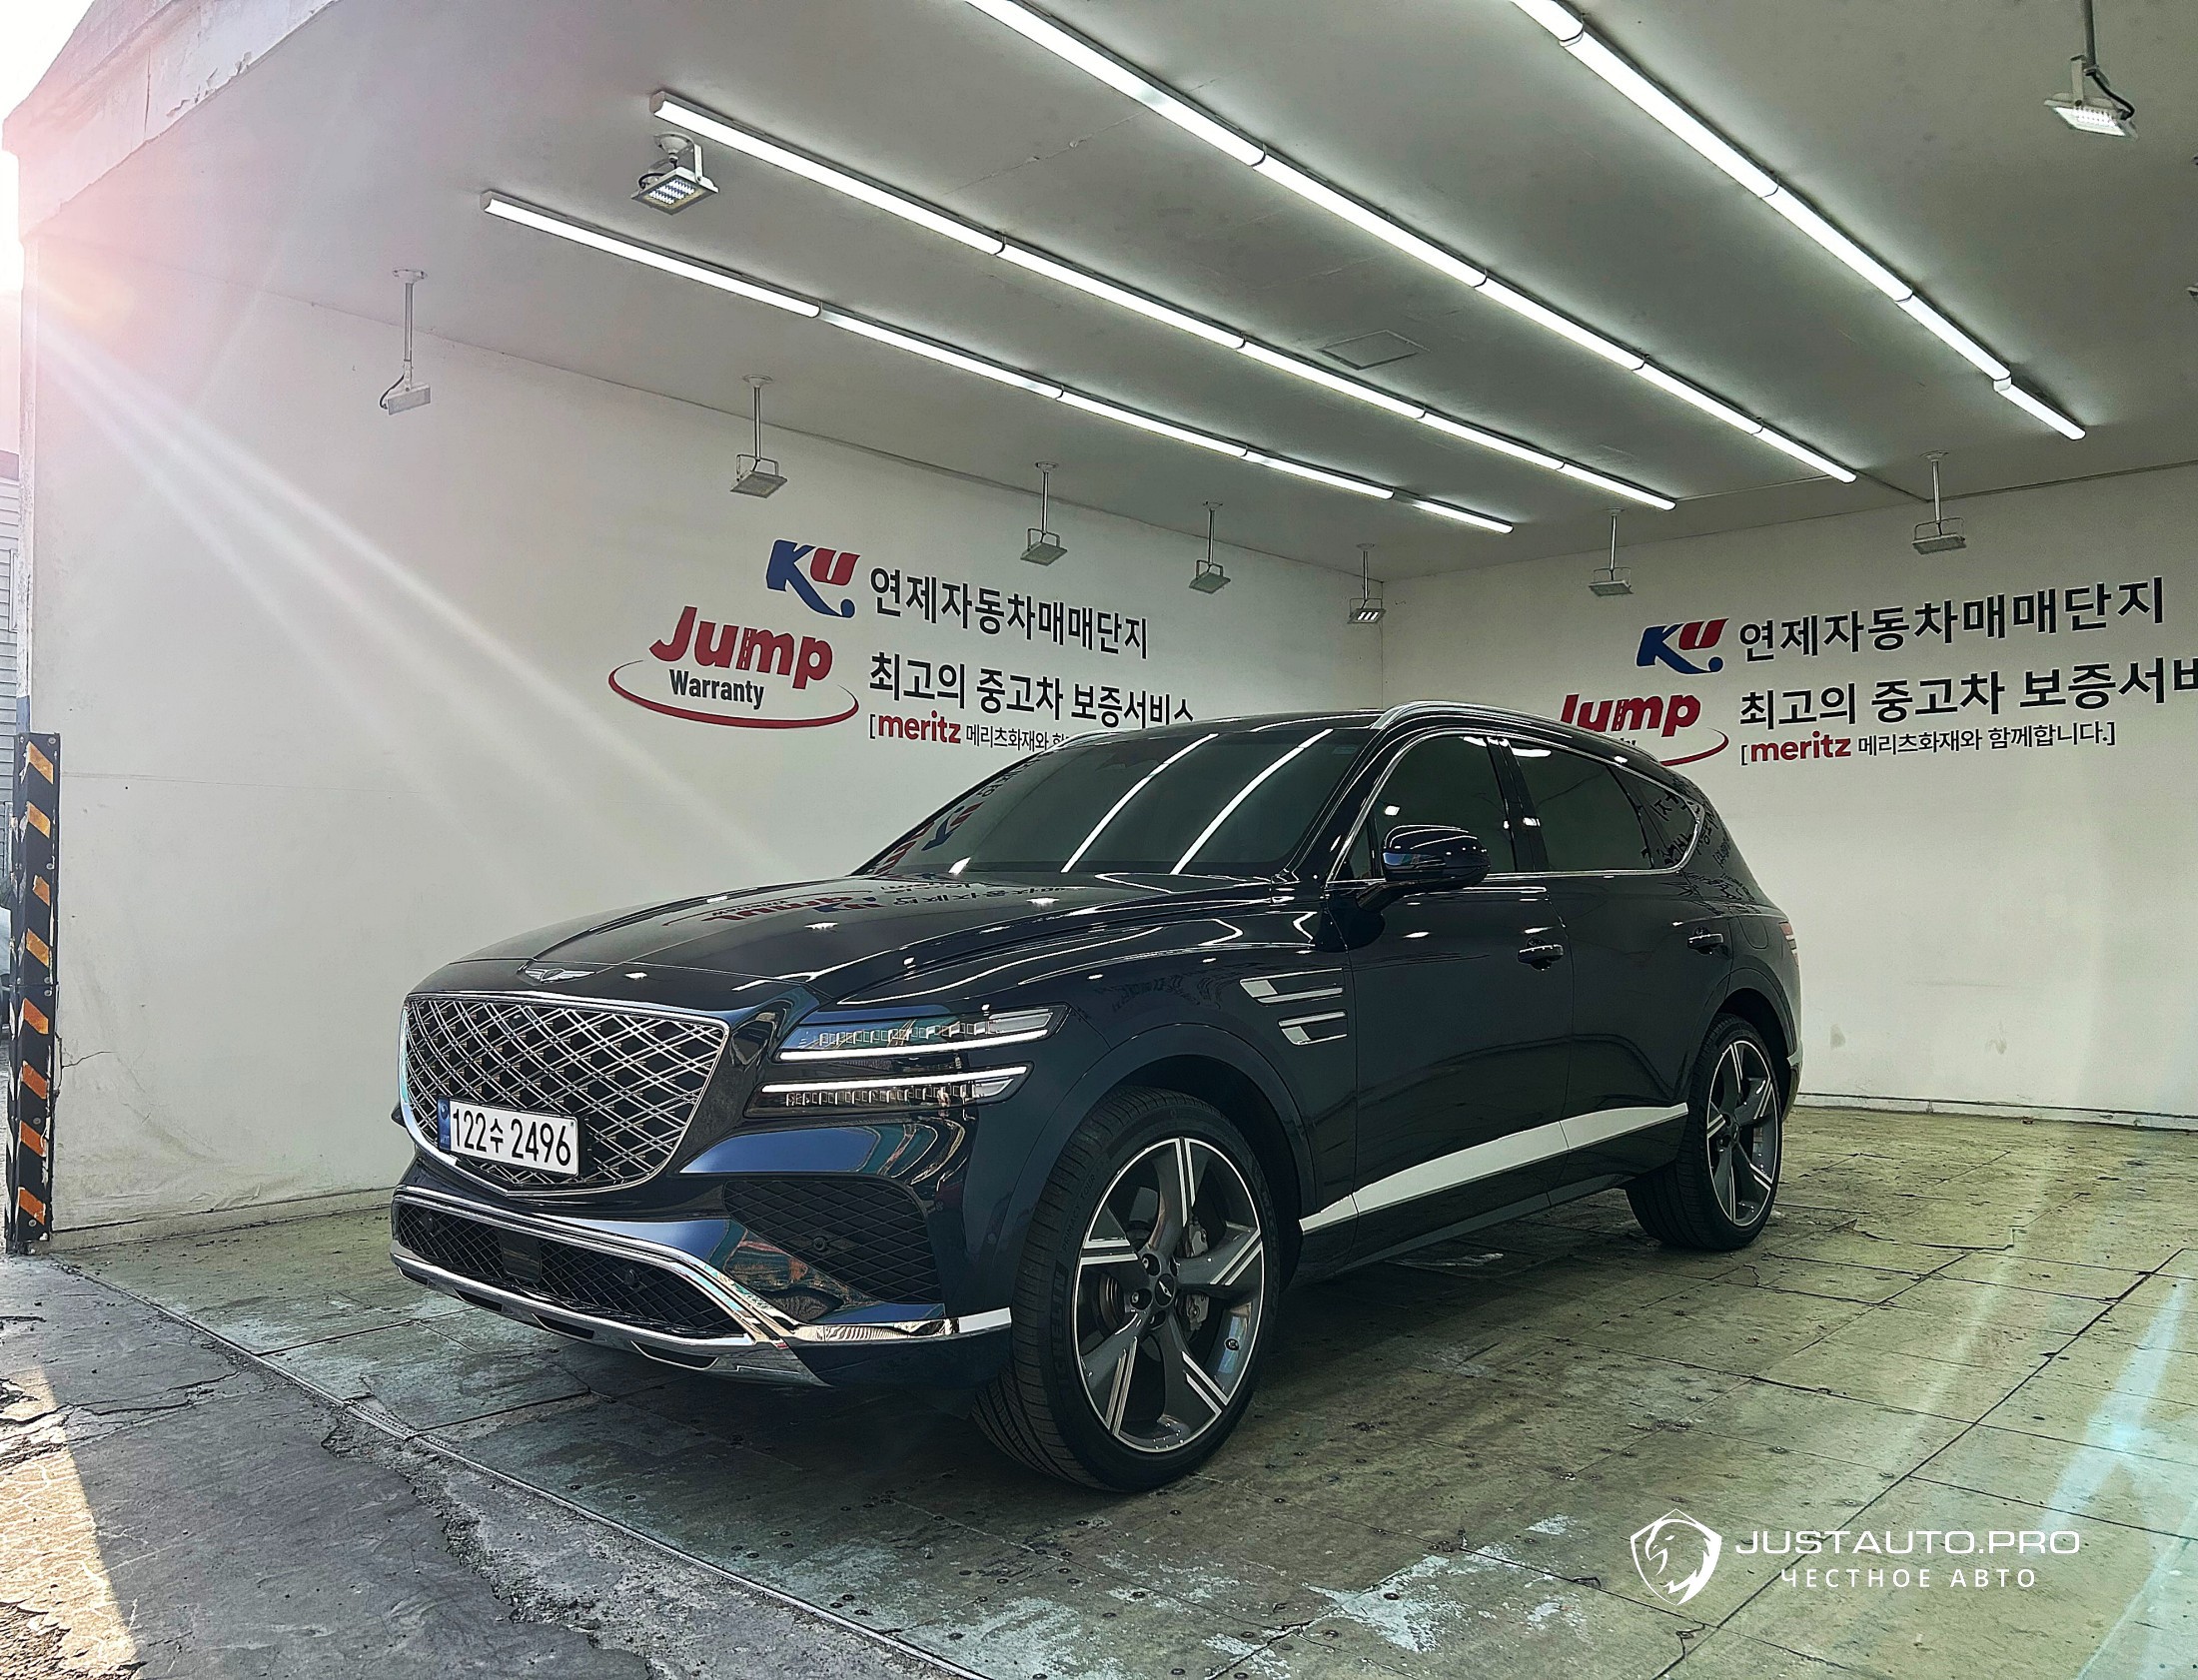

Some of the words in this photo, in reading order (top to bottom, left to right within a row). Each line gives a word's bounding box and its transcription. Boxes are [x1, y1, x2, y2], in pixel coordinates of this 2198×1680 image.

[870, 567, 1148, 659] 연제자동차매매단지
[1739, 576, 2164, 662] 연제자동차매매단지
[649, 605, 833, 690] Jump
[669, 669, 764, 710] Warranty
[869, 651, 965, 709] 최고의
[976, 668, 1063, 720] 중고차
[1739, 683, 1856, 729] 최고의
[1871, 671, 2005, 724] 중고차
[966, 724, 1049, 752] 메리츠화재와
[1858, 726, 1982, 757] 메리츠화재와
[453, 1108, 504, 1154] 122수
[511, 1118, 571, 1166] 2496
